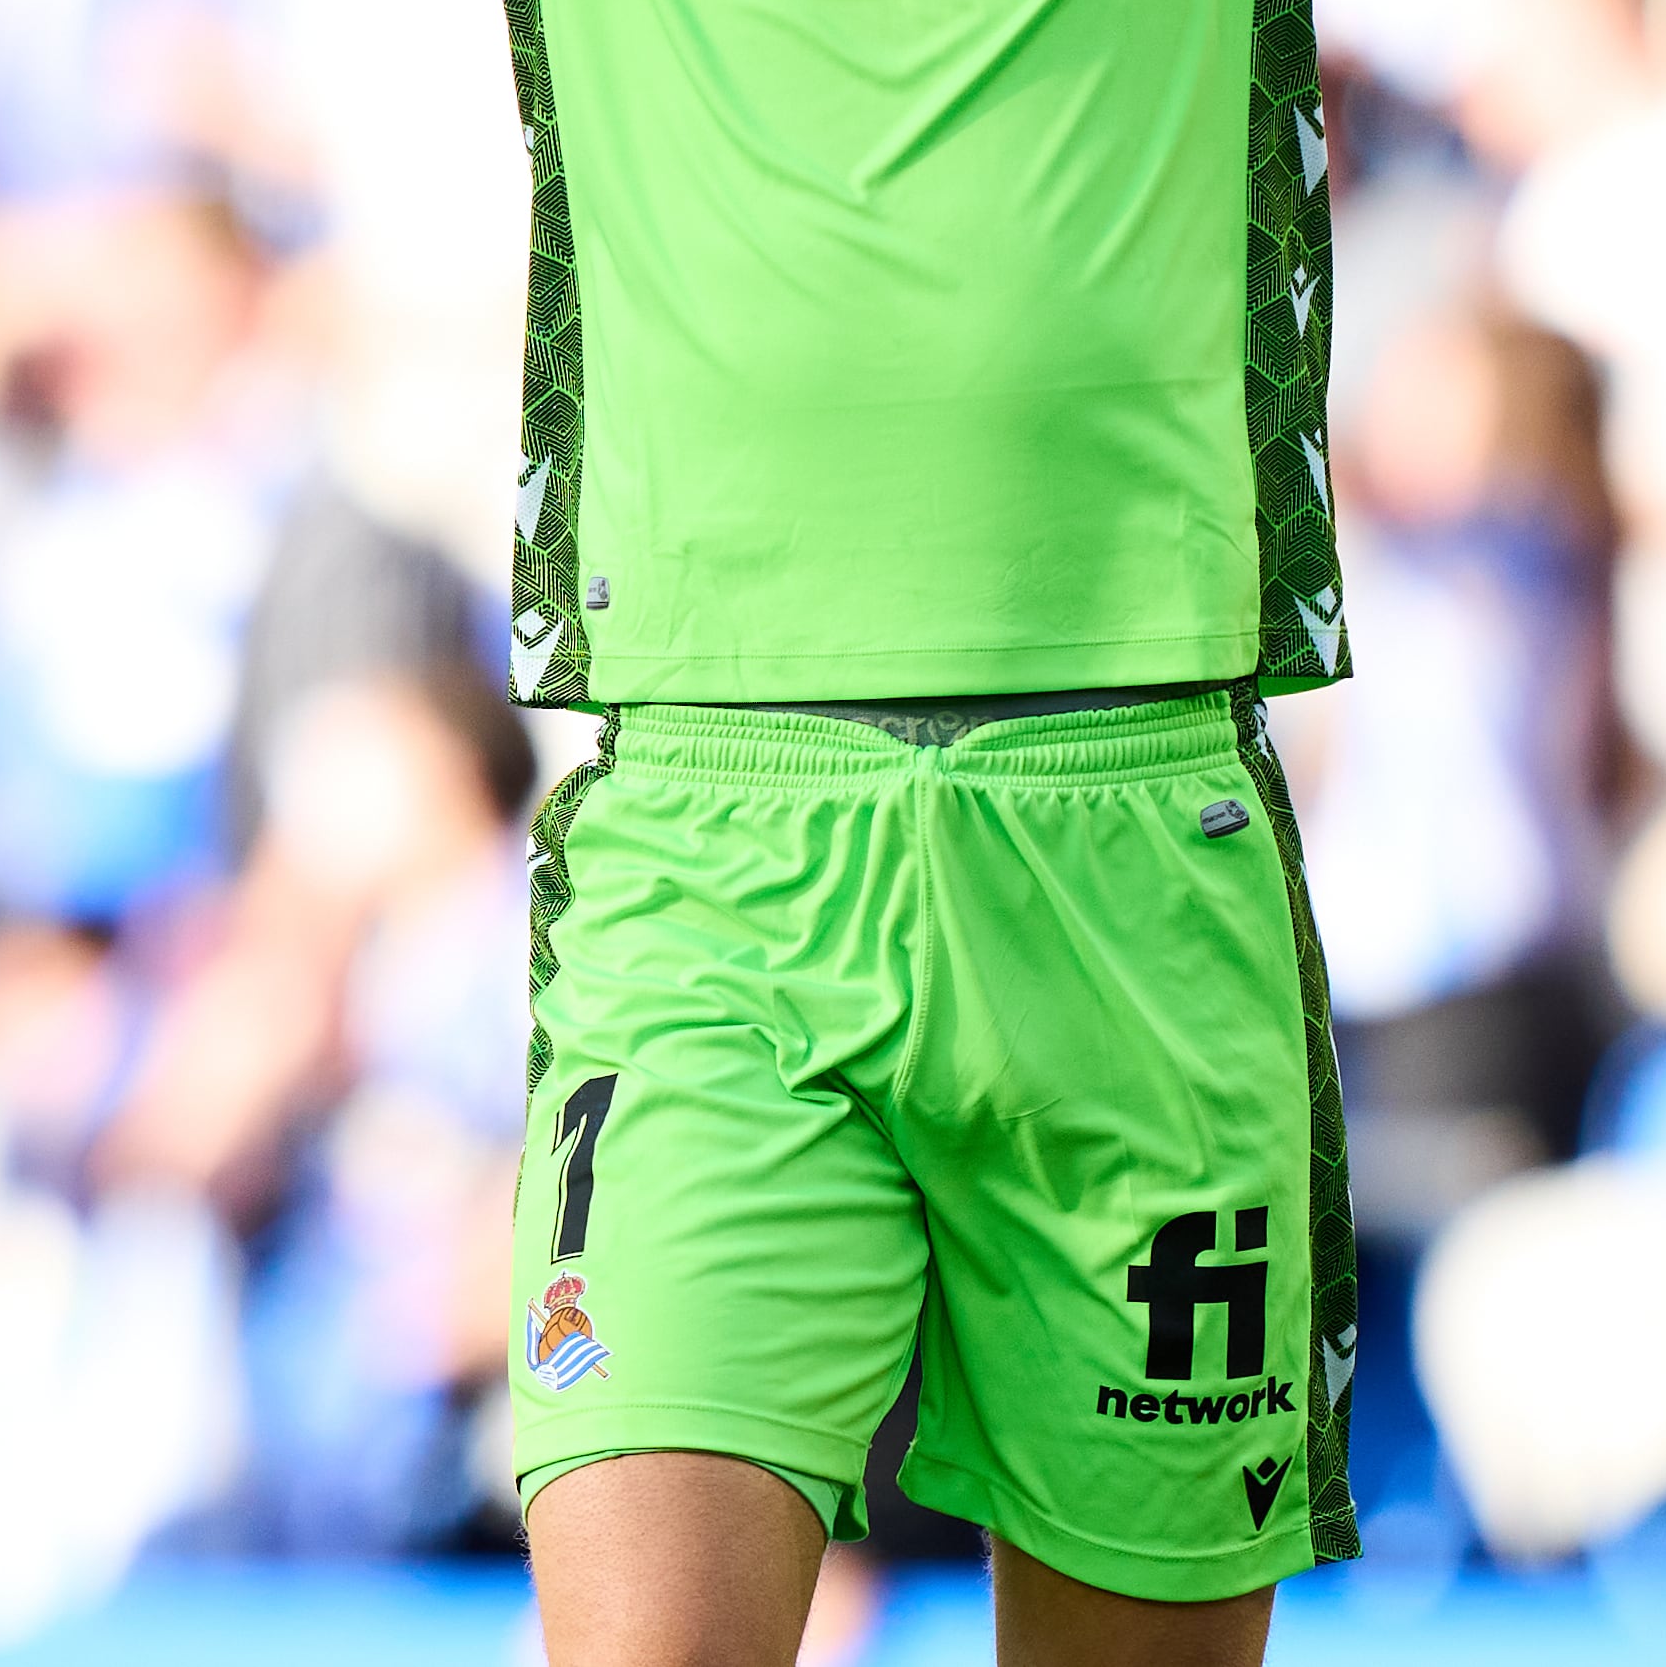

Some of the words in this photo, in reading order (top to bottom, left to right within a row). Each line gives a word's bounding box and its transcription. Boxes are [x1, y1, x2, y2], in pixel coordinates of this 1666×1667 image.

[550, 1072, 619, 1266] 1
[1127, 1205, 1269, 1381] fi
[1096, 1375, 1297, 1425] network
